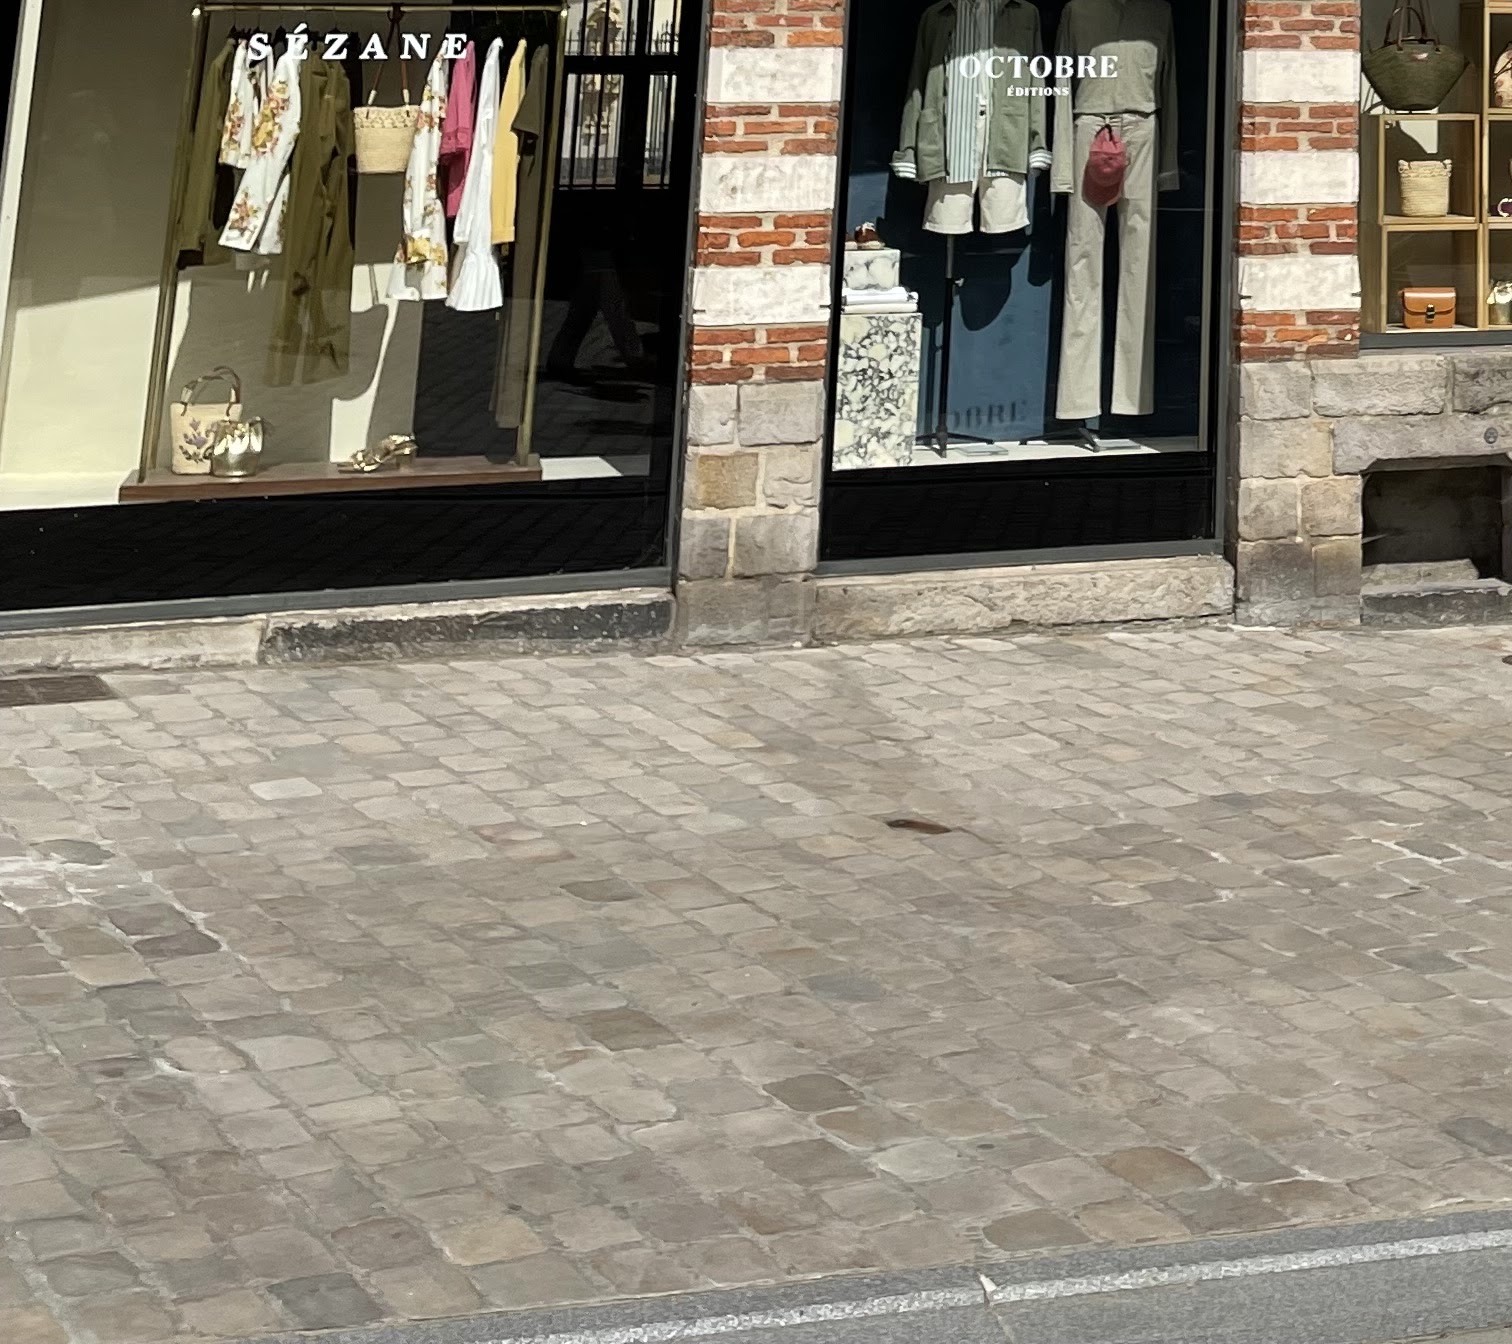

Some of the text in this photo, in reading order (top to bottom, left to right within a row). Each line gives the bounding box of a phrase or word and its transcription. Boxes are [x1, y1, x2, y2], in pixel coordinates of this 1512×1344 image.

[248, 22, 468, 60] SÉZANE
[959, 55, 1119, 79] OCTOBRE
[1006, 84, 1070, 97] ÉDITIONS
